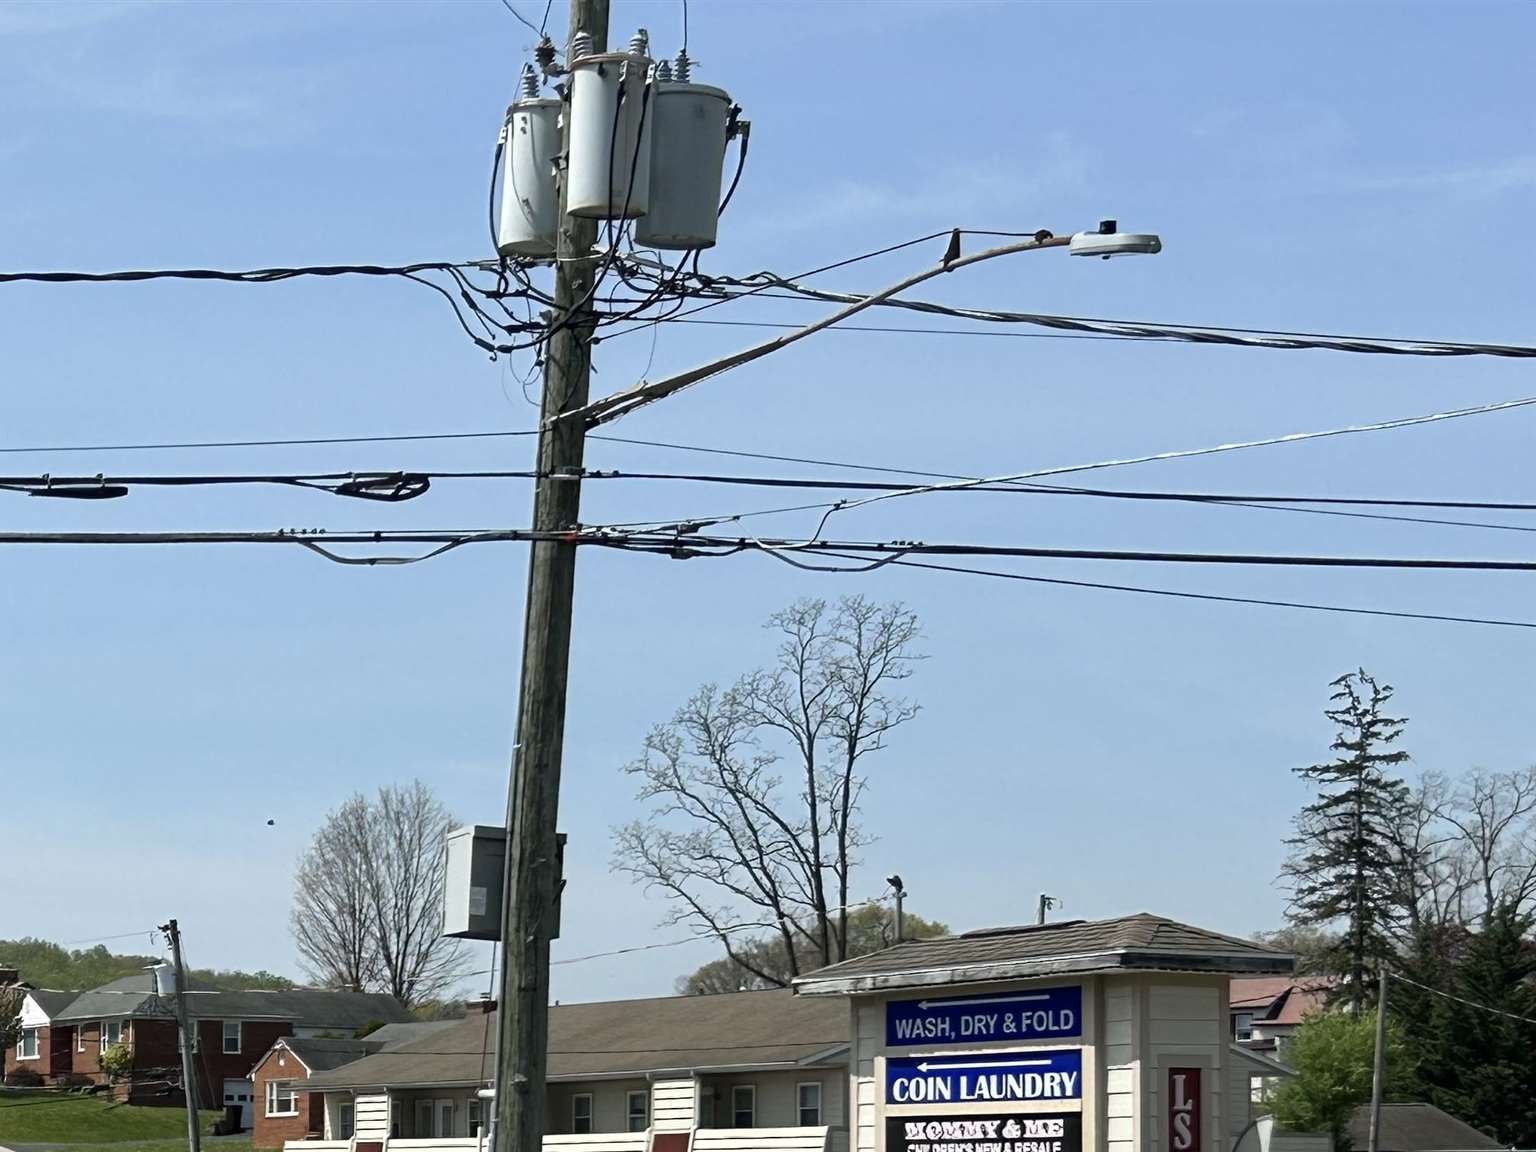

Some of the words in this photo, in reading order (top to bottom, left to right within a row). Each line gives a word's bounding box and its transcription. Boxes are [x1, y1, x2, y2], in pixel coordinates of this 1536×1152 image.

[896, 1016, 955, 1039] WASH,
[961, 1013, 998, 1036] DRY
[1003, 1012, 1017, 1034] &
[1022, 1009, 1074, 1032] FOLD
[892, 1075, 952, 1102] COIN
[960, 1071, 1077, 1100] LAUNDRY
[904, 1120, 1001, 1140] MOMMY
[1002, 1119, 1021, 1139] &
[1023, 1118, 1064, 1138] ME
